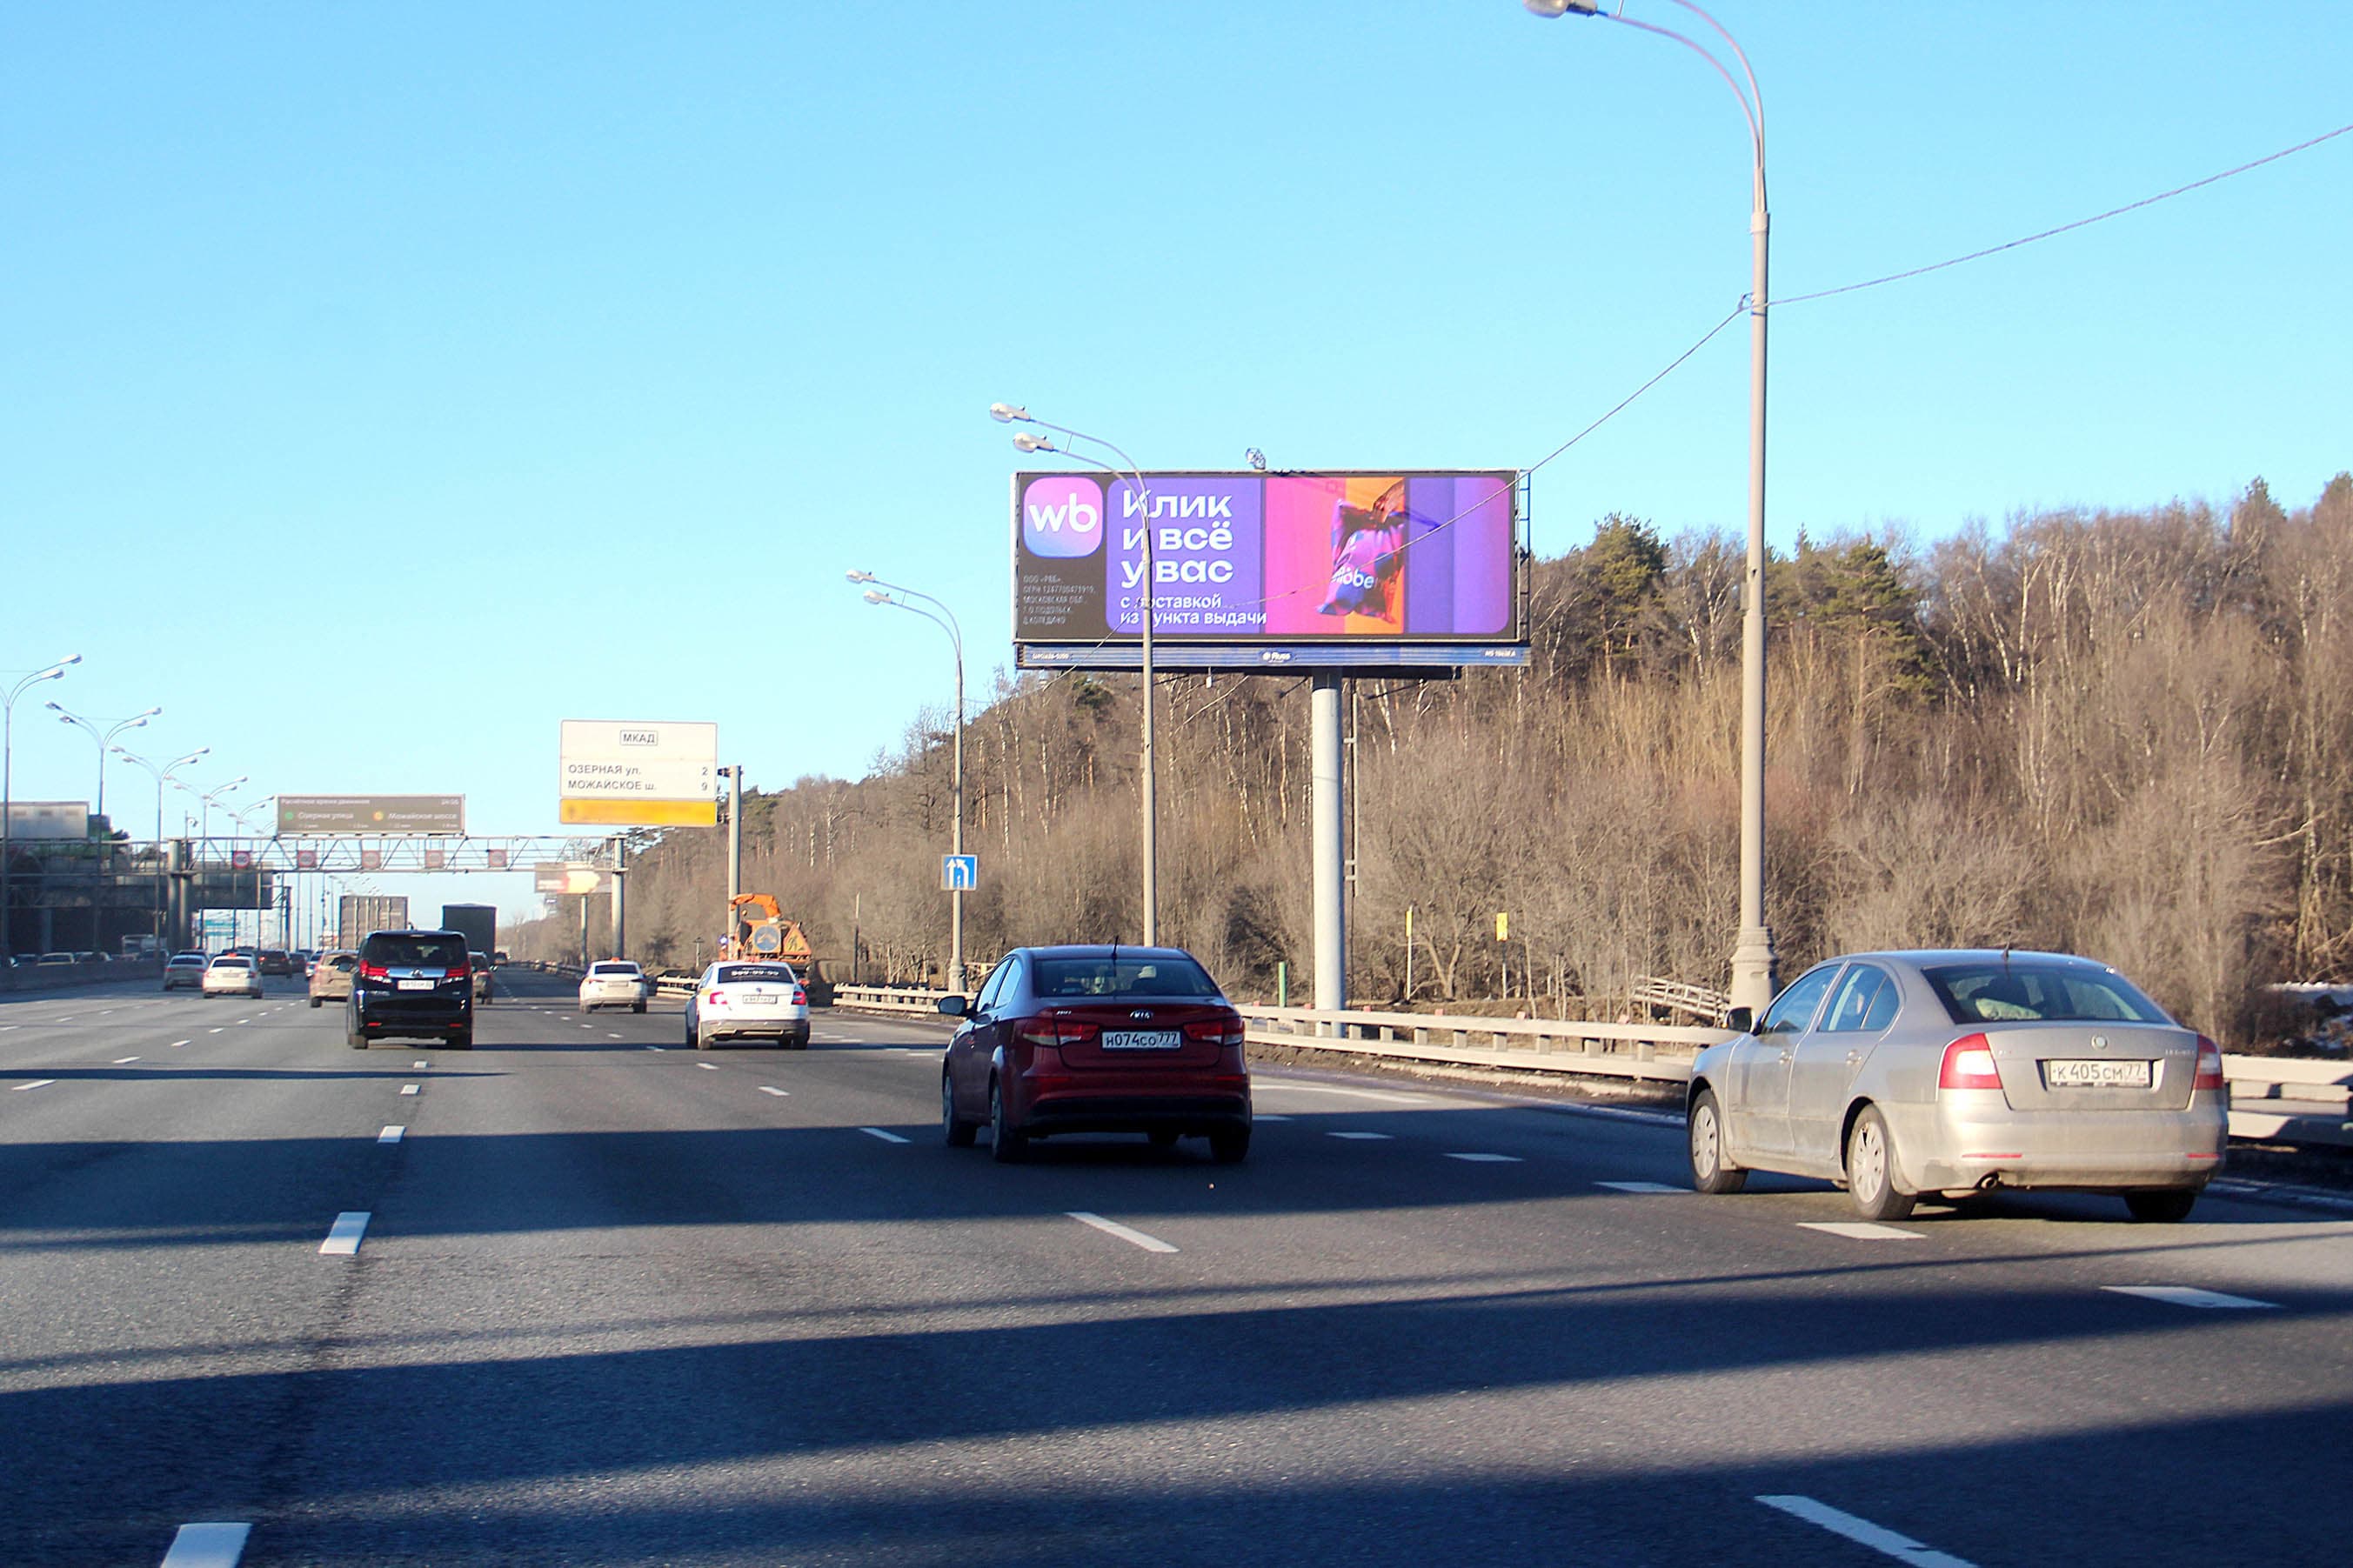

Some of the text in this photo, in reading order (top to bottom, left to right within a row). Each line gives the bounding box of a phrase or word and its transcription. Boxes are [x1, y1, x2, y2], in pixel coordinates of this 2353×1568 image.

[1122, 489, 1233, 518] Клик
[1028, 492, 1098, 533] wb
[1122, 520, 1233, 550] и всё
[1120, 559, 1233, 589] у вас
[1120, 596, 1131, 609] с
[1120, 611, 1267, 628] из ункта выдачи
[623, 733, 656, 744] МКАД
[568, 764, 709, 777] ОЗЕРНАЯ ул. 2
[567, 779, 642, 791] МОЖАЙСКОЕ
[700, 782, 708, 791] 9
